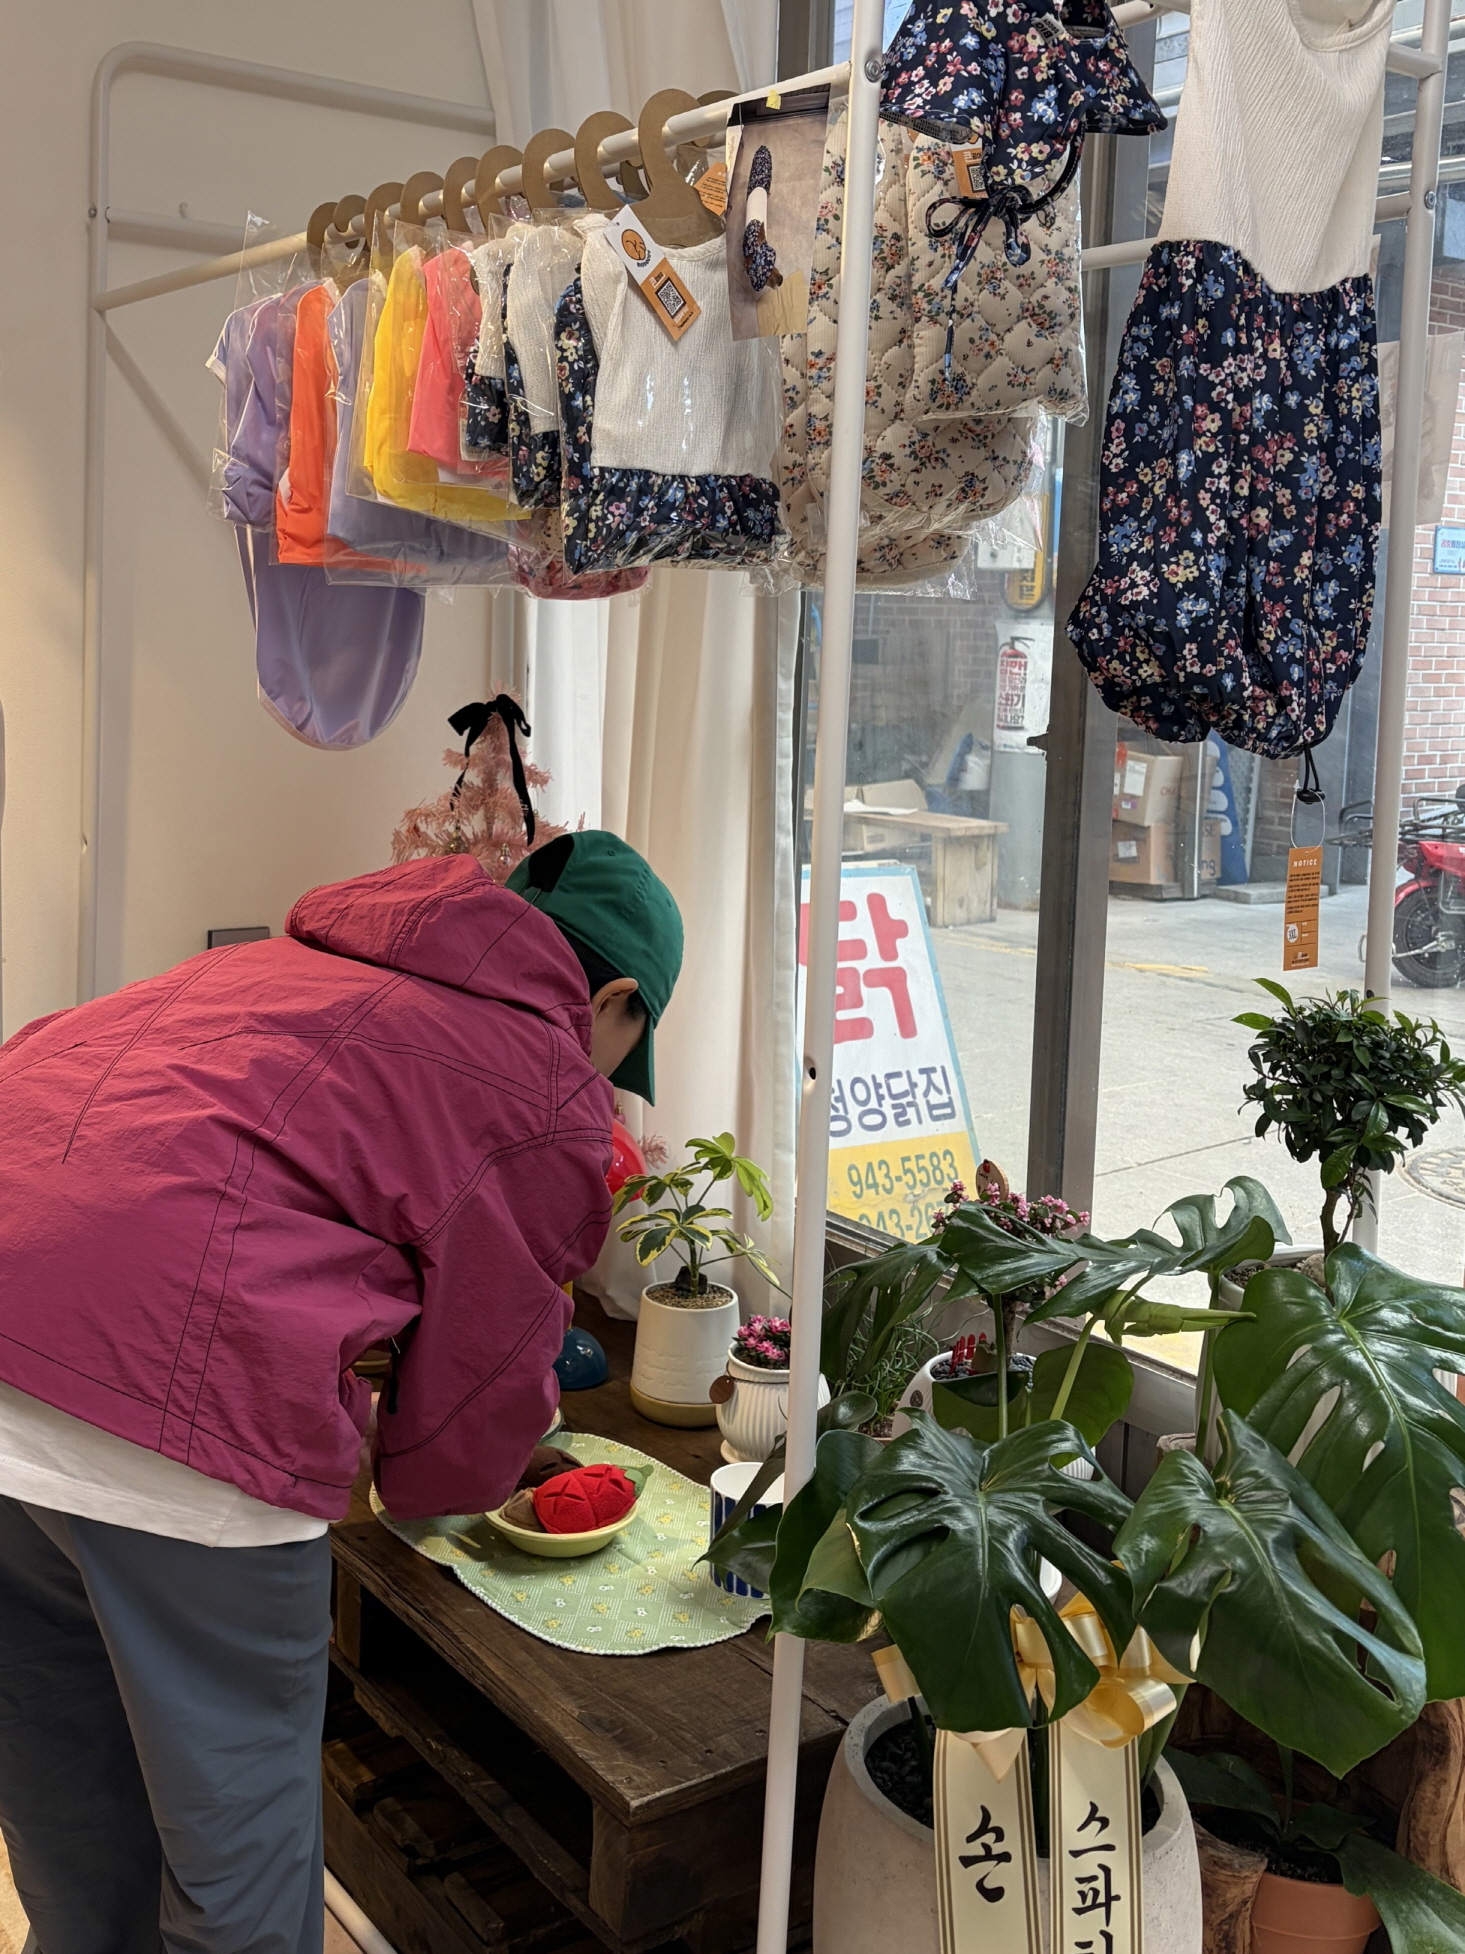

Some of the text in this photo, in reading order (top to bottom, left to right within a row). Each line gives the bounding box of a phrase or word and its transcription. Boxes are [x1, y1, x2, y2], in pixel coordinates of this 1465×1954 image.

[1035, 22, 1054, 39] BIO
[1293, 859, 1318, 868] NOTICE
[847, 1148, 959, 1200] 943-5583
[958, 1804, 1012, 1903] 손
